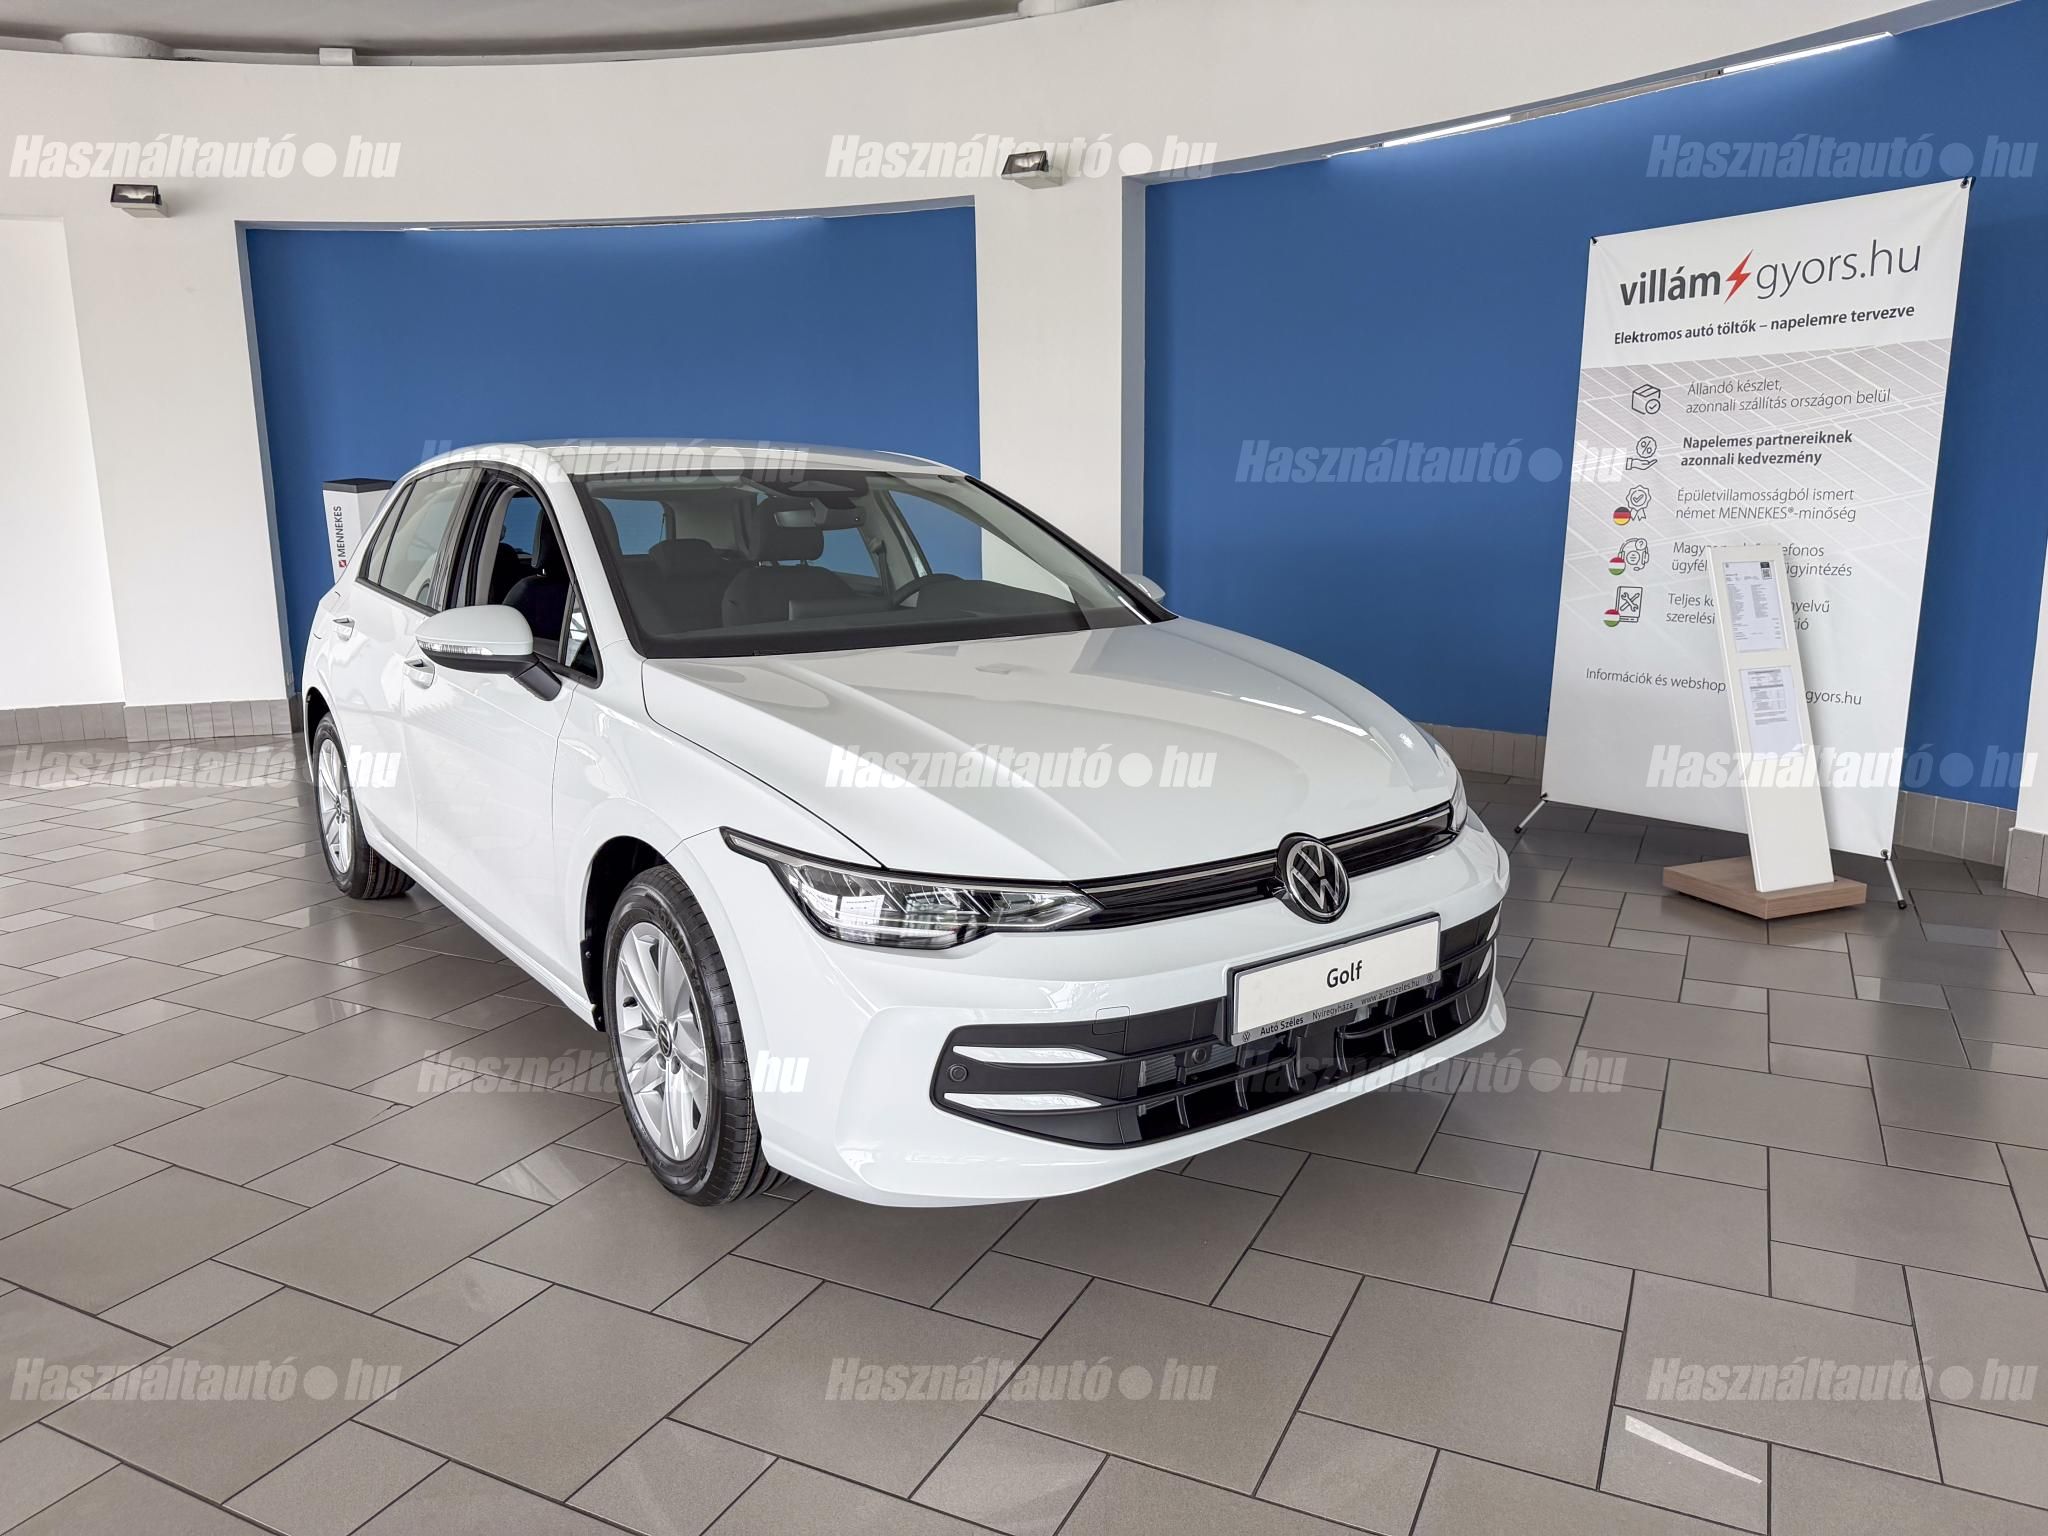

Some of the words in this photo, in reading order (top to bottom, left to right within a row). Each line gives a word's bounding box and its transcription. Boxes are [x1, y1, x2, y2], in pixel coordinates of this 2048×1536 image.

[1620, 266, 1720, 306] villám
[1756, 239, 1921, 299] gyors.hu
[1614, 328, 1682, 345] Elektromos
[1685, 324, 1714, 339] autó
[1717, 319, 1757, 336] töltők
[1770, 313, 1848, 331] napelemre
[1850, 305, 1915, 323] tervezve
[1687, 380, 1734, 396] Állandó
[1737, 378, 1783, 393] készlet,
[1686, 400, 1736, 414] azonnali
[1738, 395, 1787, 411] szállítás
[1790, 393, 1852, 408] országon
[1856, 388, 1891, 404] belül
[1682, 435, 1753, 451] Napelemes
[1755, 430, 1853, 449] partnereiknek
[1680, 452, 1734, 466] azonnali
[1737, 451, 1822, 466] kedvezmény
[1677, 486, 1810, 504] Épületvillamosságból
[1812, 488, 1855, 501] ismert
[1675, 506, 1716, 519] német
[333, 505, 346, 558] MENNEKES
[1673, 542, 1717, 557] Magy
[1780, 543, 1825, 557] efonos
[1668, 593, 1701, 608] Teljes
[1666, 611, 1716, 625] szerelési
[1586, 668, 1652, 685] Információk
[1655, 673, 1668, 687] és
[1326, 960, 1363, 989] Golf
[1259, 1023, 1279, 1037] Autó
[1280, 1016, 1304, 1030] Széles
